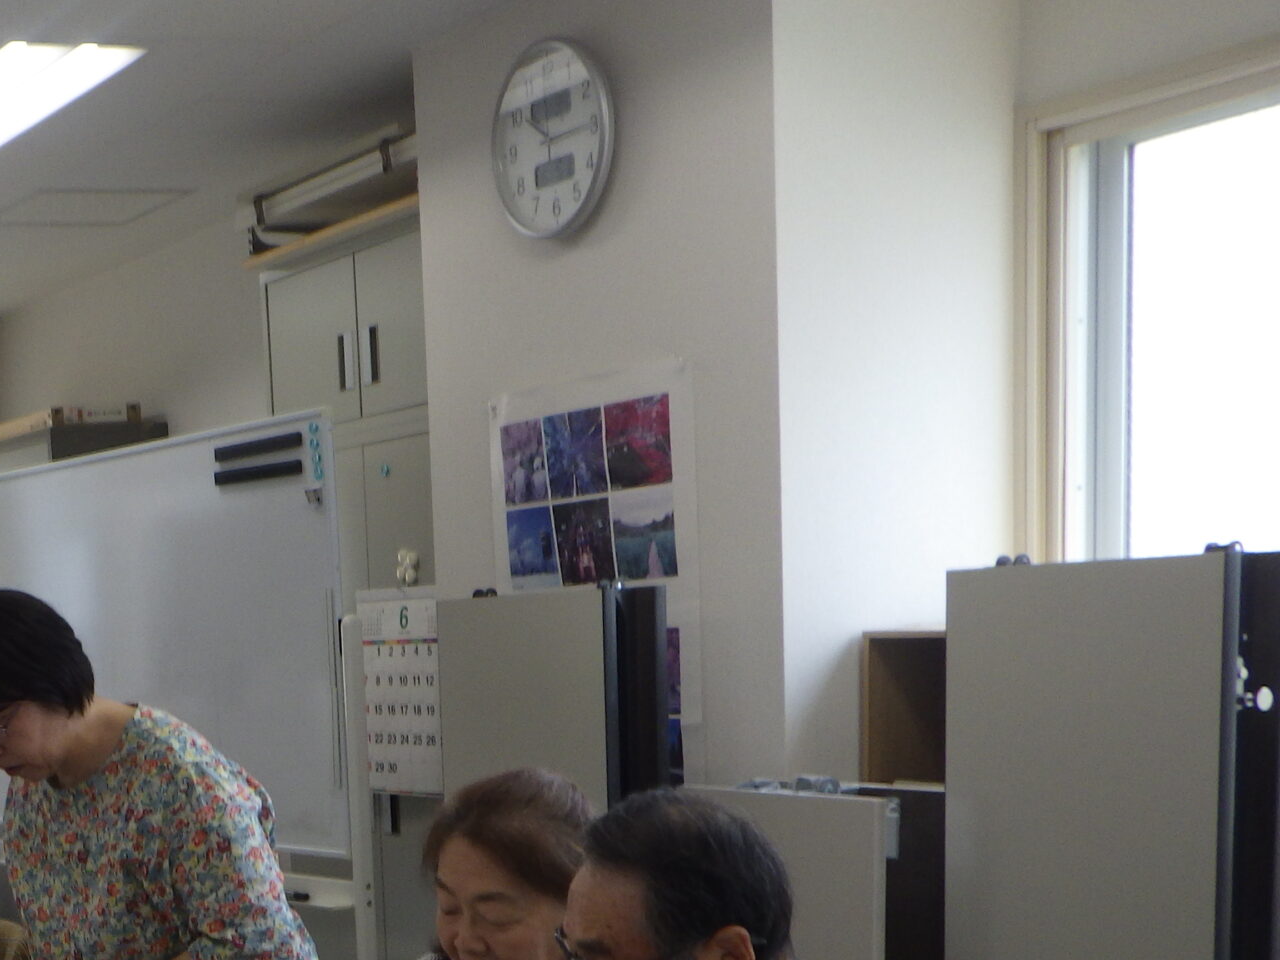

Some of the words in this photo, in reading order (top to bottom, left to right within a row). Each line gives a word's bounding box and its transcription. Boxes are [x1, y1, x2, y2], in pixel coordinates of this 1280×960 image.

[582, 81, 590, 99] 2
[511, 109, 523, 128] 10
[590, 114, 599, 134] 3
[509, 145, 518, 163] 9
[586, 151, 594, 170] 4
[516, 178, 525, 196] 8
[573, 182, 582, 202] 5
[532, 197, 540, 215] 7
[552, 197, 561, 216] 6
[399, 605, 409, 629] 6
[399, 674, 408, 686] 10
[413, 674, 421, 686] 11
[426, 674, 434, 686] 12
[374, 704, 383, 716] 15
[387, 704, 396, 716] 16
[400, 704, 409, 716] 17
[413, 704, 422, 716] 18
[426, 704, 435, 716] 19
[374, 733, 384, 744] 22
[387, 734, 397, 745] 23
[400, 734, 409, 745] 24
[413, 735, 423, 746] 25
[426, 735, 437, 746] 26
[375, 761, 385, 773] 29
[388, 762, 398, 773] 30
